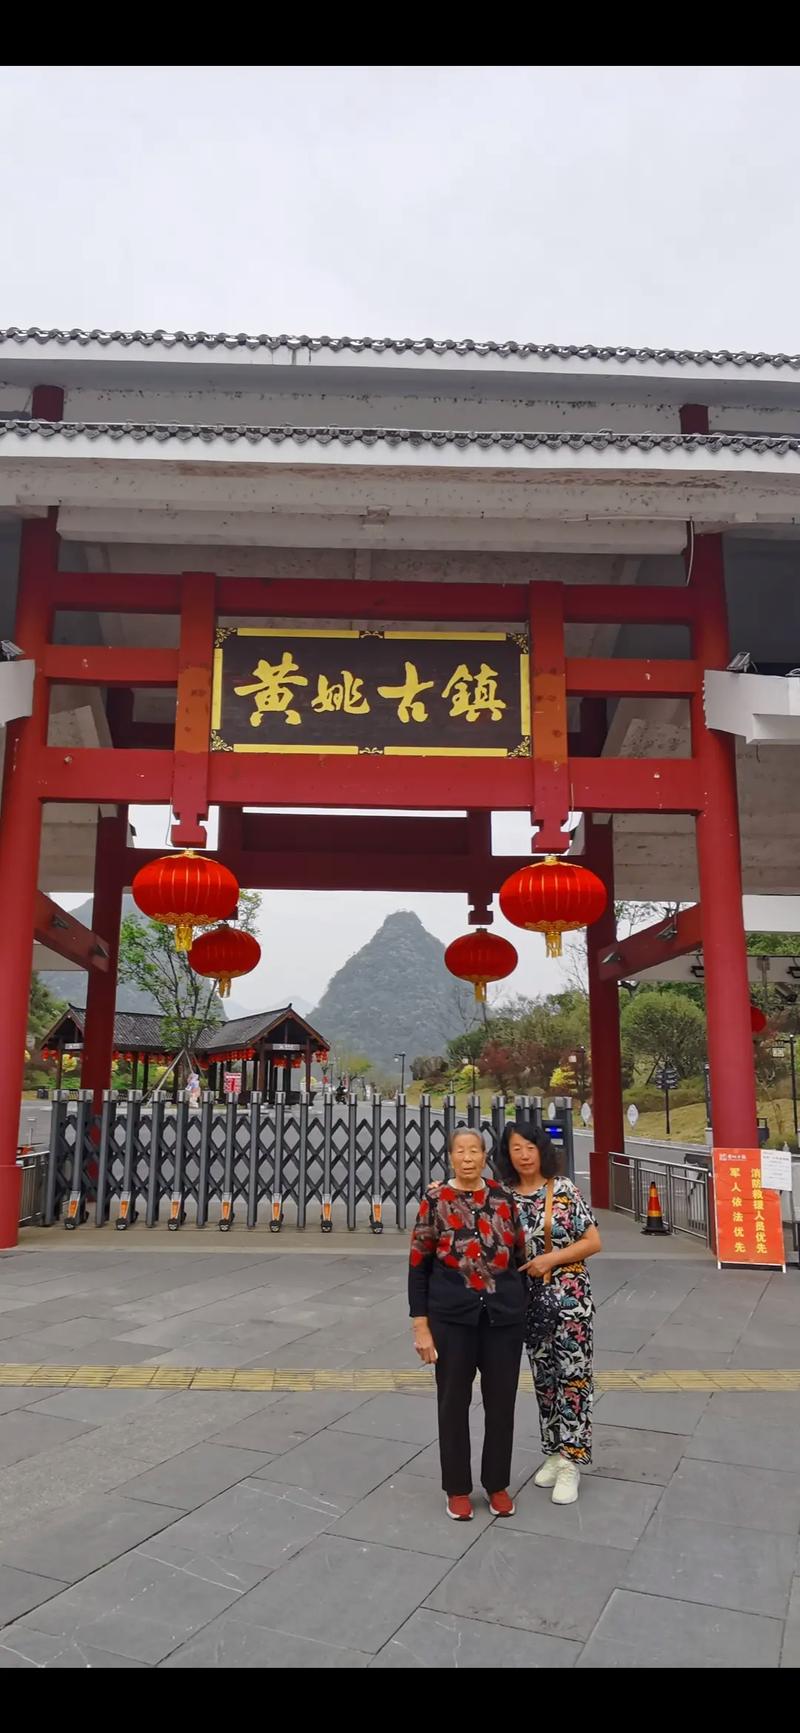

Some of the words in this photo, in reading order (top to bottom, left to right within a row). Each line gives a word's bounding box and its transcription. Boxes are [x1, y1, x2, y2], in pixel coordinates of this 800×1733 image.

[729, 1167, 746, 1253] 军人依法优先
[751, 1168, 767, 1254] 消防救援人员优先
